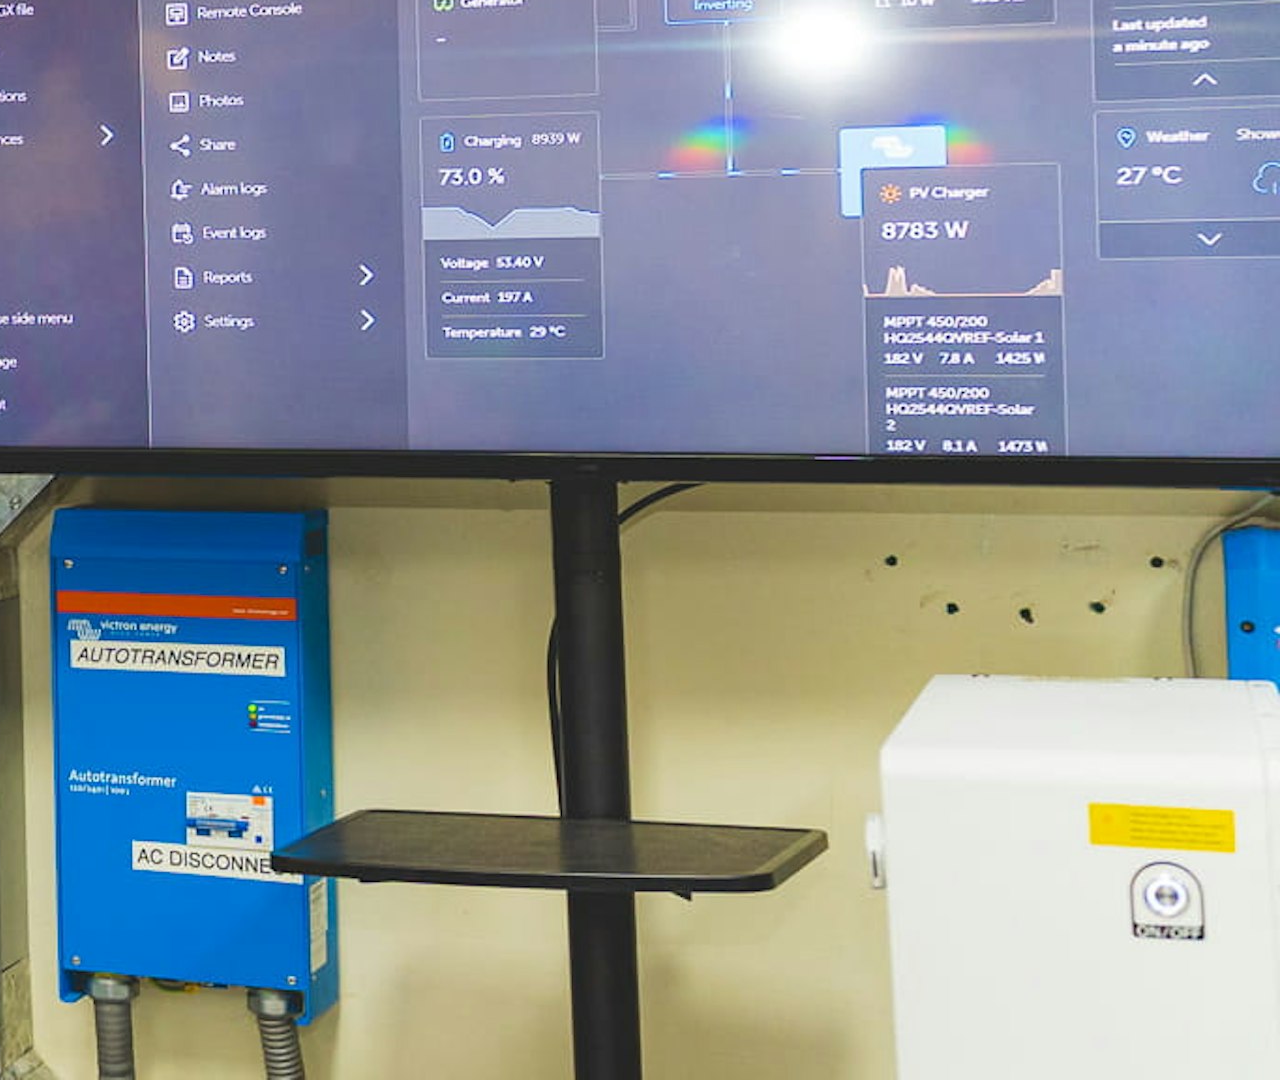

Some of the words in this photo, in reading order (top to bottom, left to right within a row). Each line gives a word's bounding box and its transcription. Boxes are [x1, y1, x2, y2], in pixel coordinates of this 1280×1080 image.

[15, 2, 35, 16] file
[197, 6, 247, 20] Remote
[249, 2, 303, 17] Console
[1112, 19, 1143, 31] Last
[1145, 15, 1208, 32] updated
[1112, 43, 1123, 52] a
[1125, 39, 1178, 52] minute
[1179, 39, 1211, 53] ago
[198, 50, 236, 63] Notes
[199, 94, 244, 107] Photos
[199, 137, 236, 151] Share
[464, 134, 522, 149] Charging
[532, 132, 564, 145] 8939
[566, 131, 582, 144] W
[1145, 130, 1211, 143] Weather
[439, 168, 482, 186] 73.0
[488, 167, 506, 185] %
[1116, 166, 1148, 186] 27
[1151, 165, 1184, 185] °C
[200, 182, 238, 196] Alarm
[240, 182, 268, 197] logs
[909, 186, 930, 199] PV
[930, 185, 990, 201] Charger
[202, 226, 238, 239] Event
[240, 226, 267, 240] logs
[881, 221, 938, 240] 8783
[944, 220, 970, 239] W
[440, 256, 489, 270] Voltage
[533, 255, 545, 268] V
[203, 270, 253, 286] Reports
[441, 291, 491, 304] Current
[522, 291, 533, 303] A
[11, 312, 35, 325] side
[37, 313, 73, 325] menu
[204, 314, 255, 331] Settings
[883, 316, 924, 328] MPPT
[927, 315, 988, 328] 450/200
[443, 326, 523, 340] Temperature
[548, 324, 566, 337] °C
[1034, 330, 1045, 343] 1
[962, 352, 975, 364] A
[885, 387, 927, 399] MPPT
[928, 386, 989, 399] 450/200
[885, 419, 897, 431] 2
[965, 440, 978, 452] A
[100, 620, 137, 631] victron
[139, 622, 178, 635] energy
[77, 647, 280, 671] AUTOTRANSFORMER
[68, 768, 178, 788] Autotransformer
[137, 849, 164, 865] AC
[169, 850, 285, 875] DISCONNE
